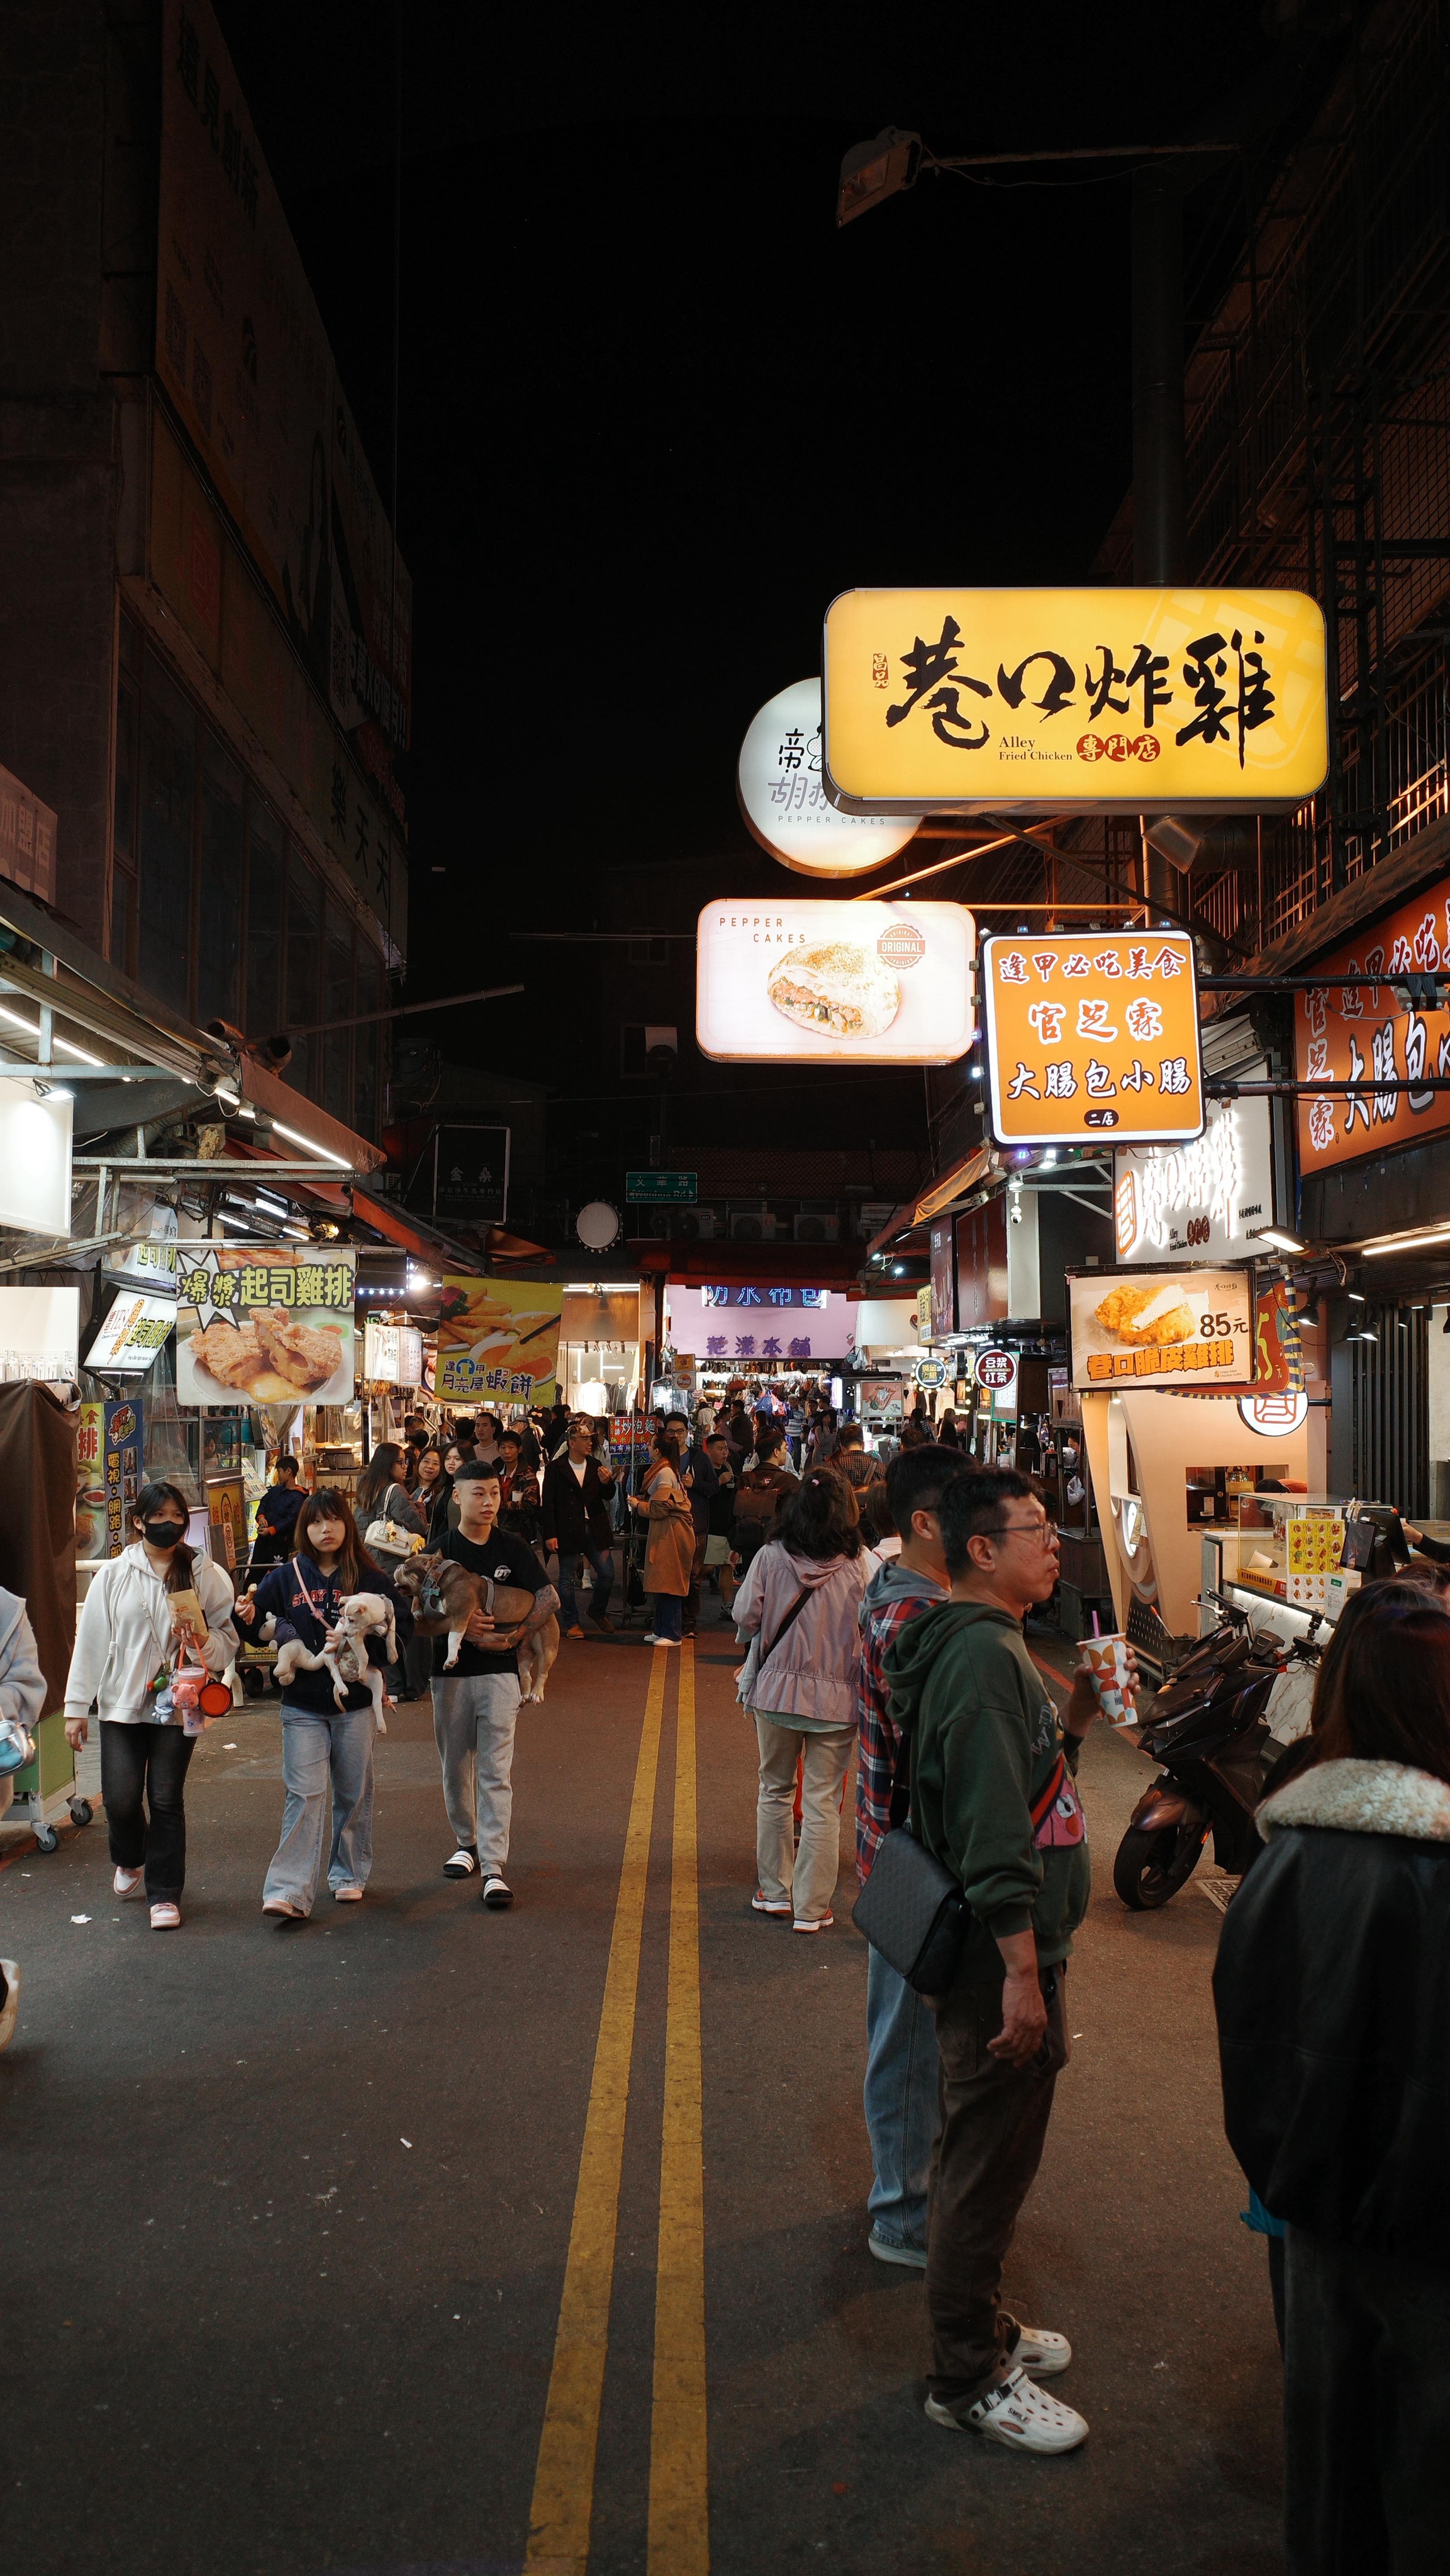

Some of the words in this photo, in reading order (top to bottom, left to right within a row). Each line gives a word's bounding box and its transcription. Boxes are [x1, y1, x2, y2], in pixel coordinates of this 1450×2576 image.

[885, 615, 1276, 770] 巷口炸雞
[998, 736, 1036, 752] Alley
[1078, 734, 1159, 762] 專門店
[998, 752, 1027, 760] Fried
[1029, 752, 1073, 760] Chicken
[778, 815, 831, 823] PEPPER
[841, 817, 886, 825] CAKES
[719, 918, 783, 927] PEPPER
[753, 934, 806, 943] CAKES
[881, 941, 922, 953] ORIGINAL
[999, 946, 1186, 983] 逢甲必吃美食
[1029, 998, 1163, 1044] 官芝霖
[1007, 1057, 1192, 1100] 大腸包小腸
[1088, 1112, 1115, 1126] 二店
[635, 1176, 689, 1187] 文華路
[1200, 1313, 1249, 1338] 85元
[1087, 1340, 1234, 1381] 巷口脆皮雞排
[622, 1418, 655, 1435] 炒泡麵
[78, 1427, 98, 1460] 排
[292, 1589, 327, 1607] STAY
